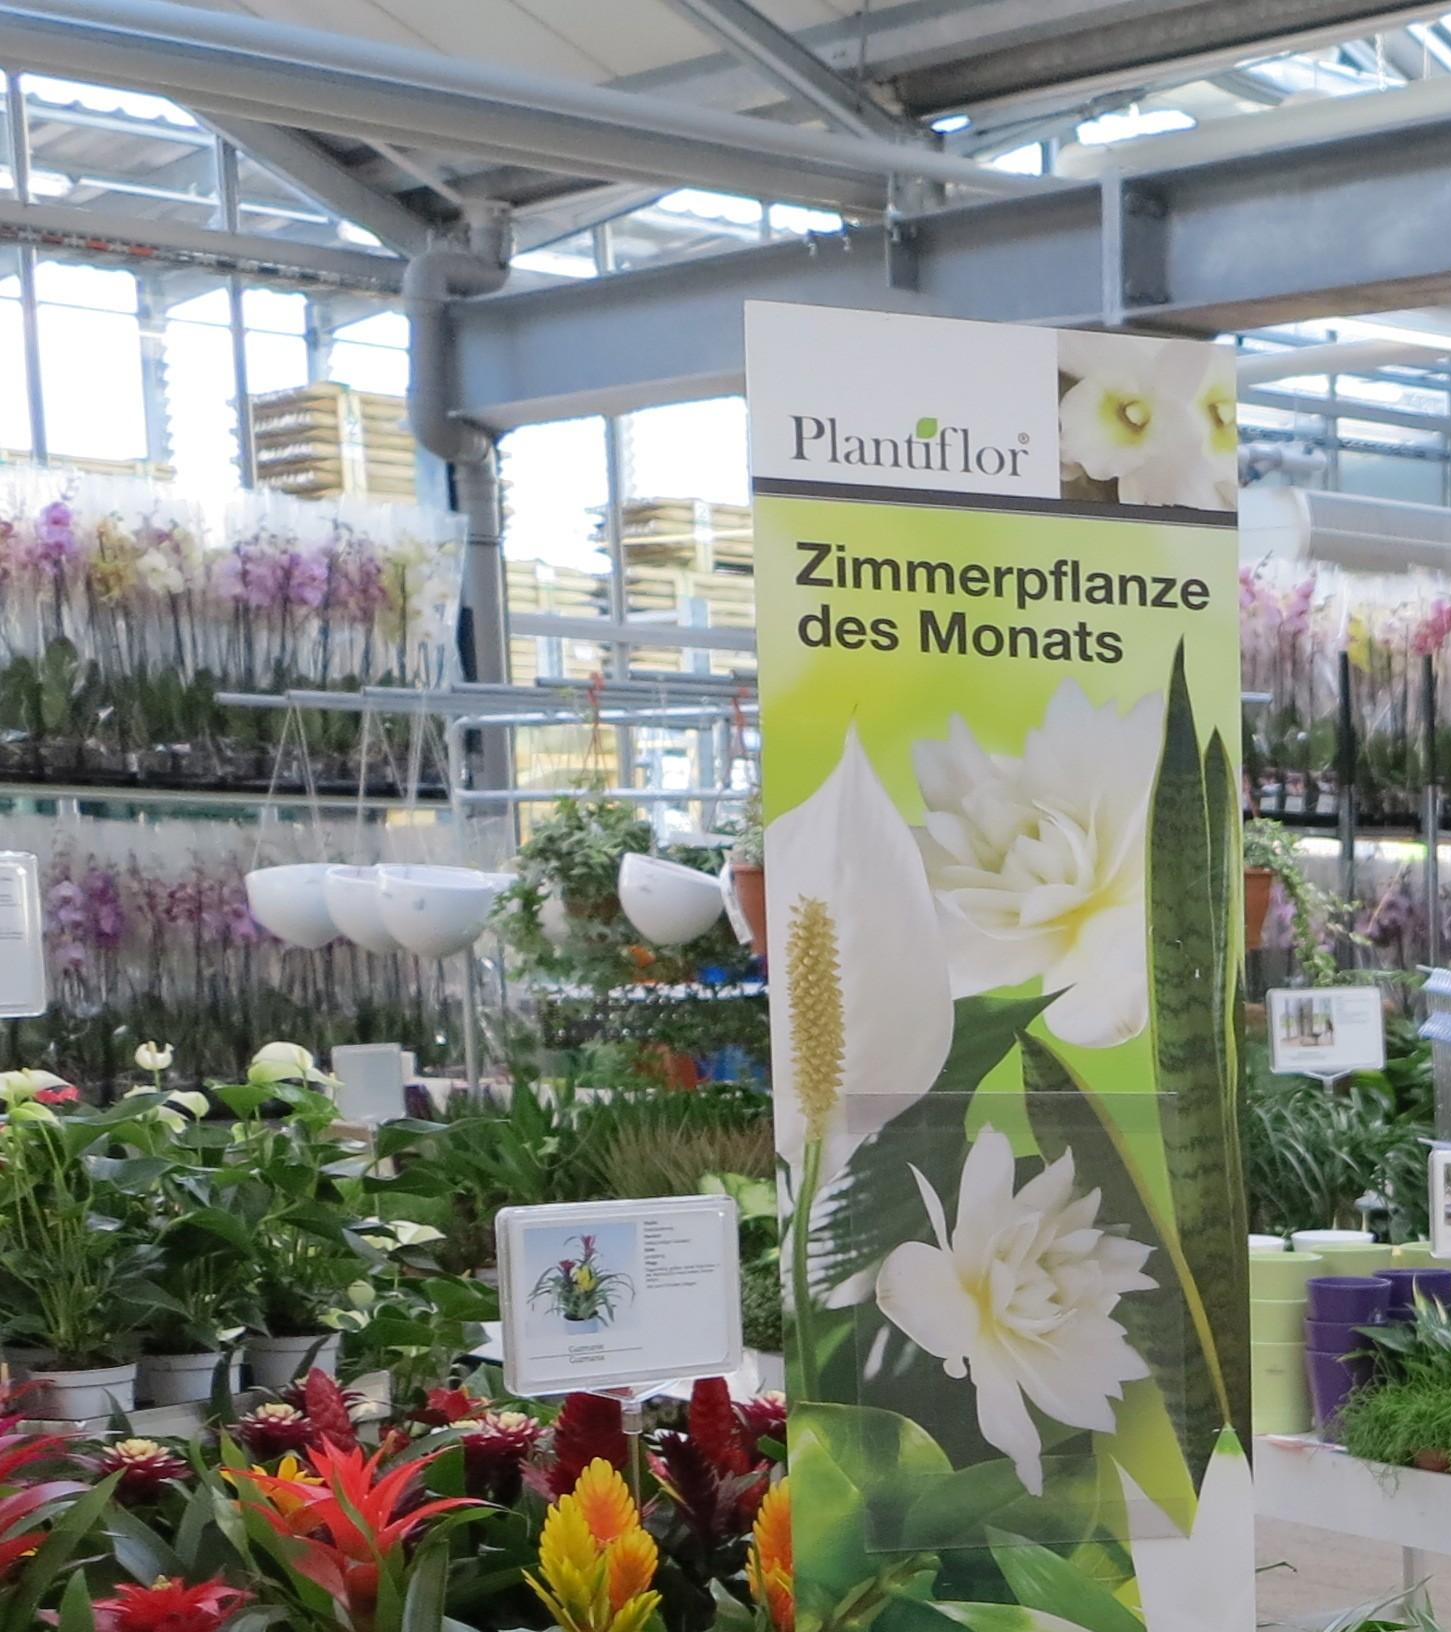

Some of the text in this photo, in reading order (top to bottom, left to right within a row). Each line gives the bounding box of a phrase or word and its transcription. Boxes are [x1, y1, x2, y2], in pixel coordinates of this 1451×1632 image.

[789, 415, 1028, 477] Plantiflor
[796, 542, 1210, 611] Zimmerpflanze
[798, 605, 1123, 664] des Monats
